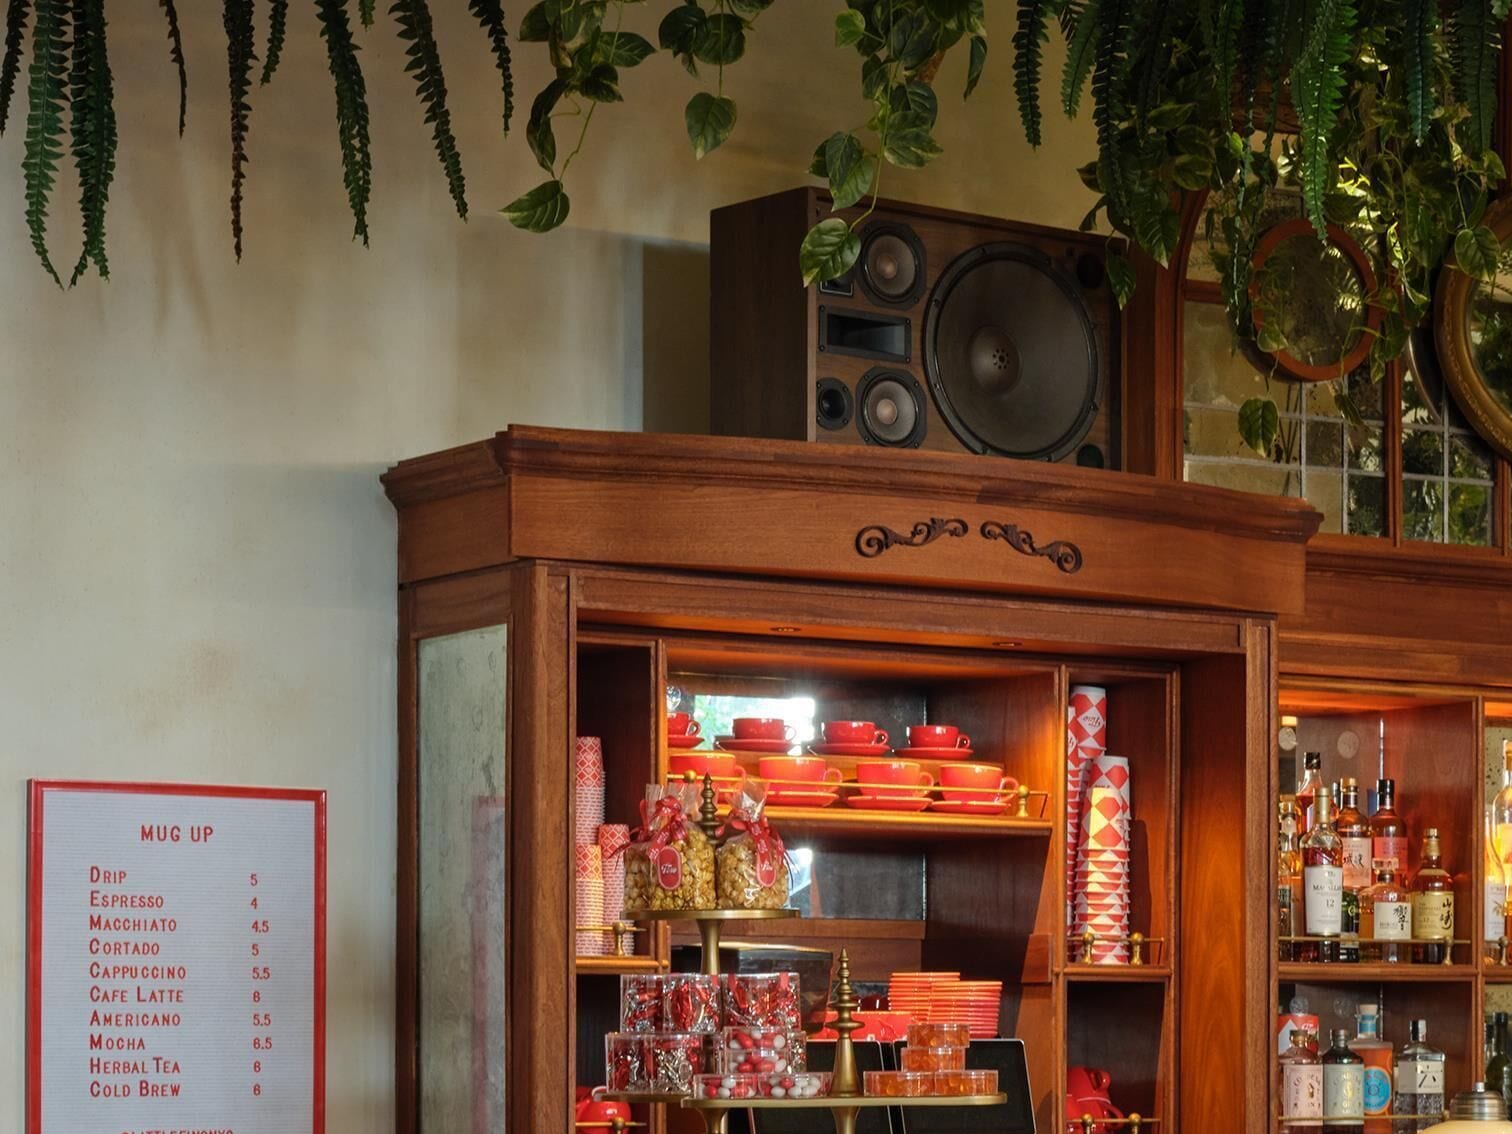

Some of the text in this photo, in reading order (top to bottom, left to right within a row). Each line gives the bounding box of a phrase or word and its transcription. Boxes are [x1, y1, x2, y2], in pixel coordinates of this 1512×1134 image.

[140, 825, 214, 843] MUG UP
[89, 865, 127, 884] DRIP
[249, 873, 258, 887] 5
[89, 890, 164, 909] ESPRESSO
[250, 896, 258, 910] 4
[89, 915, 177, 932] MACCHIATO
[251, 920, 269, 933] 4.5
[89, 937, 160, 955] CORTADO
[251, 943, 260, 957] 5
[89, 961, 187, 980] CAPPUCCINO
[252, 967, 271, 980] 5.5
[89, 985, 184, 1003] CAFE LATTE
[89, 1010, 181, 1027] AMERICANO
[252, 1013, 272, 1027] 5.5
[89, 1033, 146, 1050] MOCHA
[89, 1056, 181, 1074] HERBAL TEA
[89, 1080, 181, 1098] COLD BREW
[252, 1083, 262, 1096] 6
